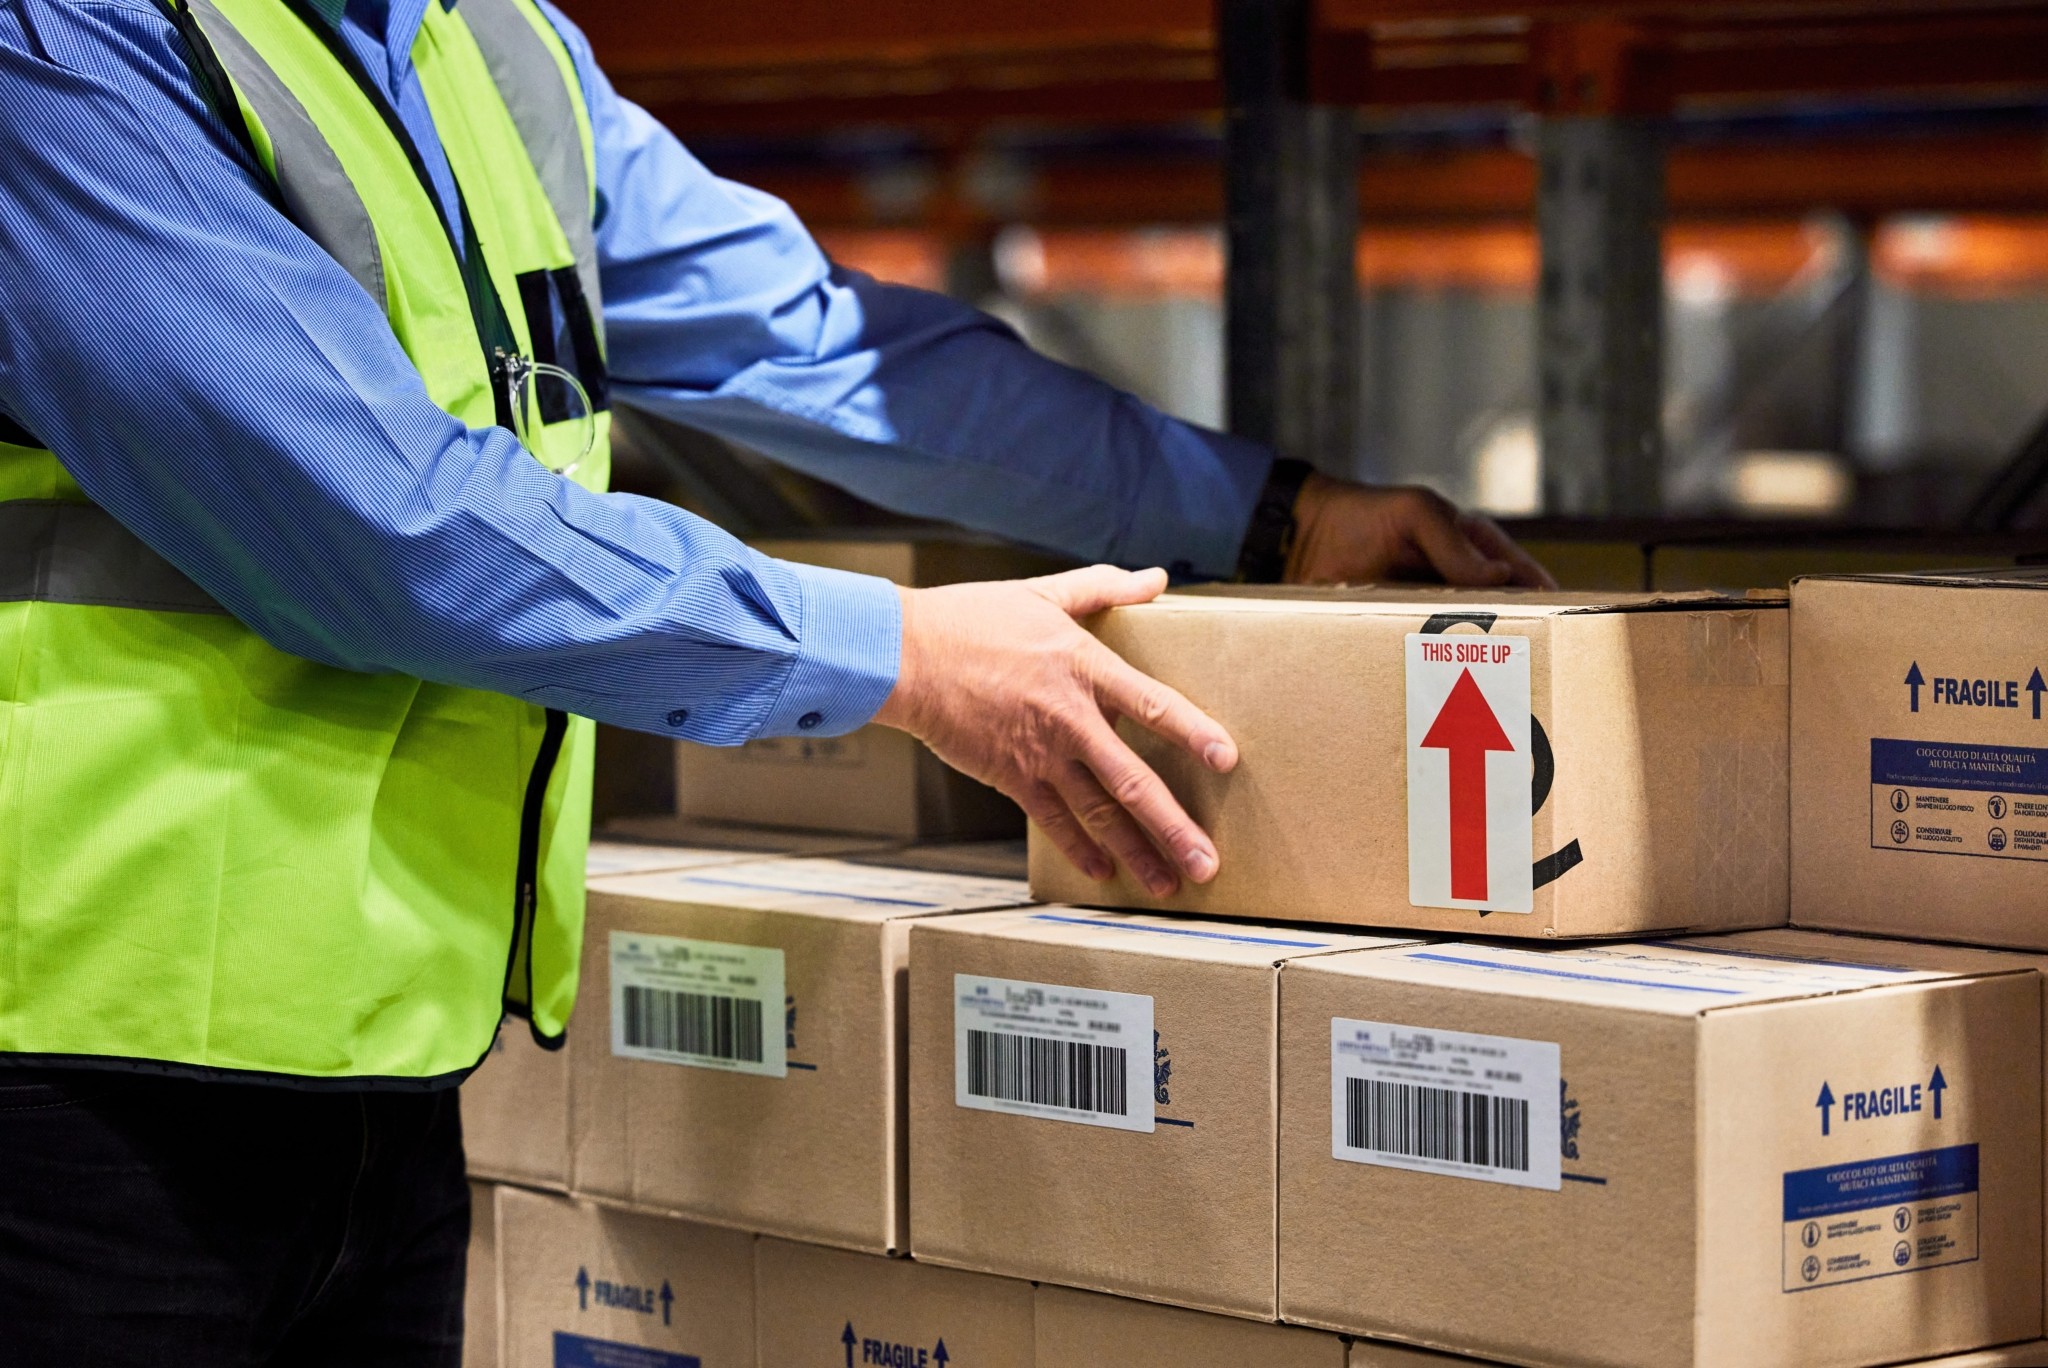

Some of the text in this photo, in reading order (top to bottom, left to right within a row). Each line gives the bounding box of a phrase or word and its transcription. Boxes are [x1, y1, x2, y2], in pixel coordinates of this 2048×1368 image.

[1422, 643, 1511, 664] THIS SIDE UP
[1933, 678, 2018, 708] FRAGILE
[1916, 748, 1968, 760] CIOCCOLATO
[1970, 751, 1980, 760] DI
[1981, 752, 2000, 762] ALTA
[1928, 760, 2021, 773] AIUTACI A MANTENERLA
[1916, 796, 1949, 804] MANTENERE
[1916, 827, 1952, 835] CONSERVARE
[2014, 830, 2047, 838] COLLOCARE
[1844, 1084, 1922, 1122] FRAGILE
[594, 1280, 654, 1314] FRAGILE
[862, 1338, 928, 1368] FRAGILE
